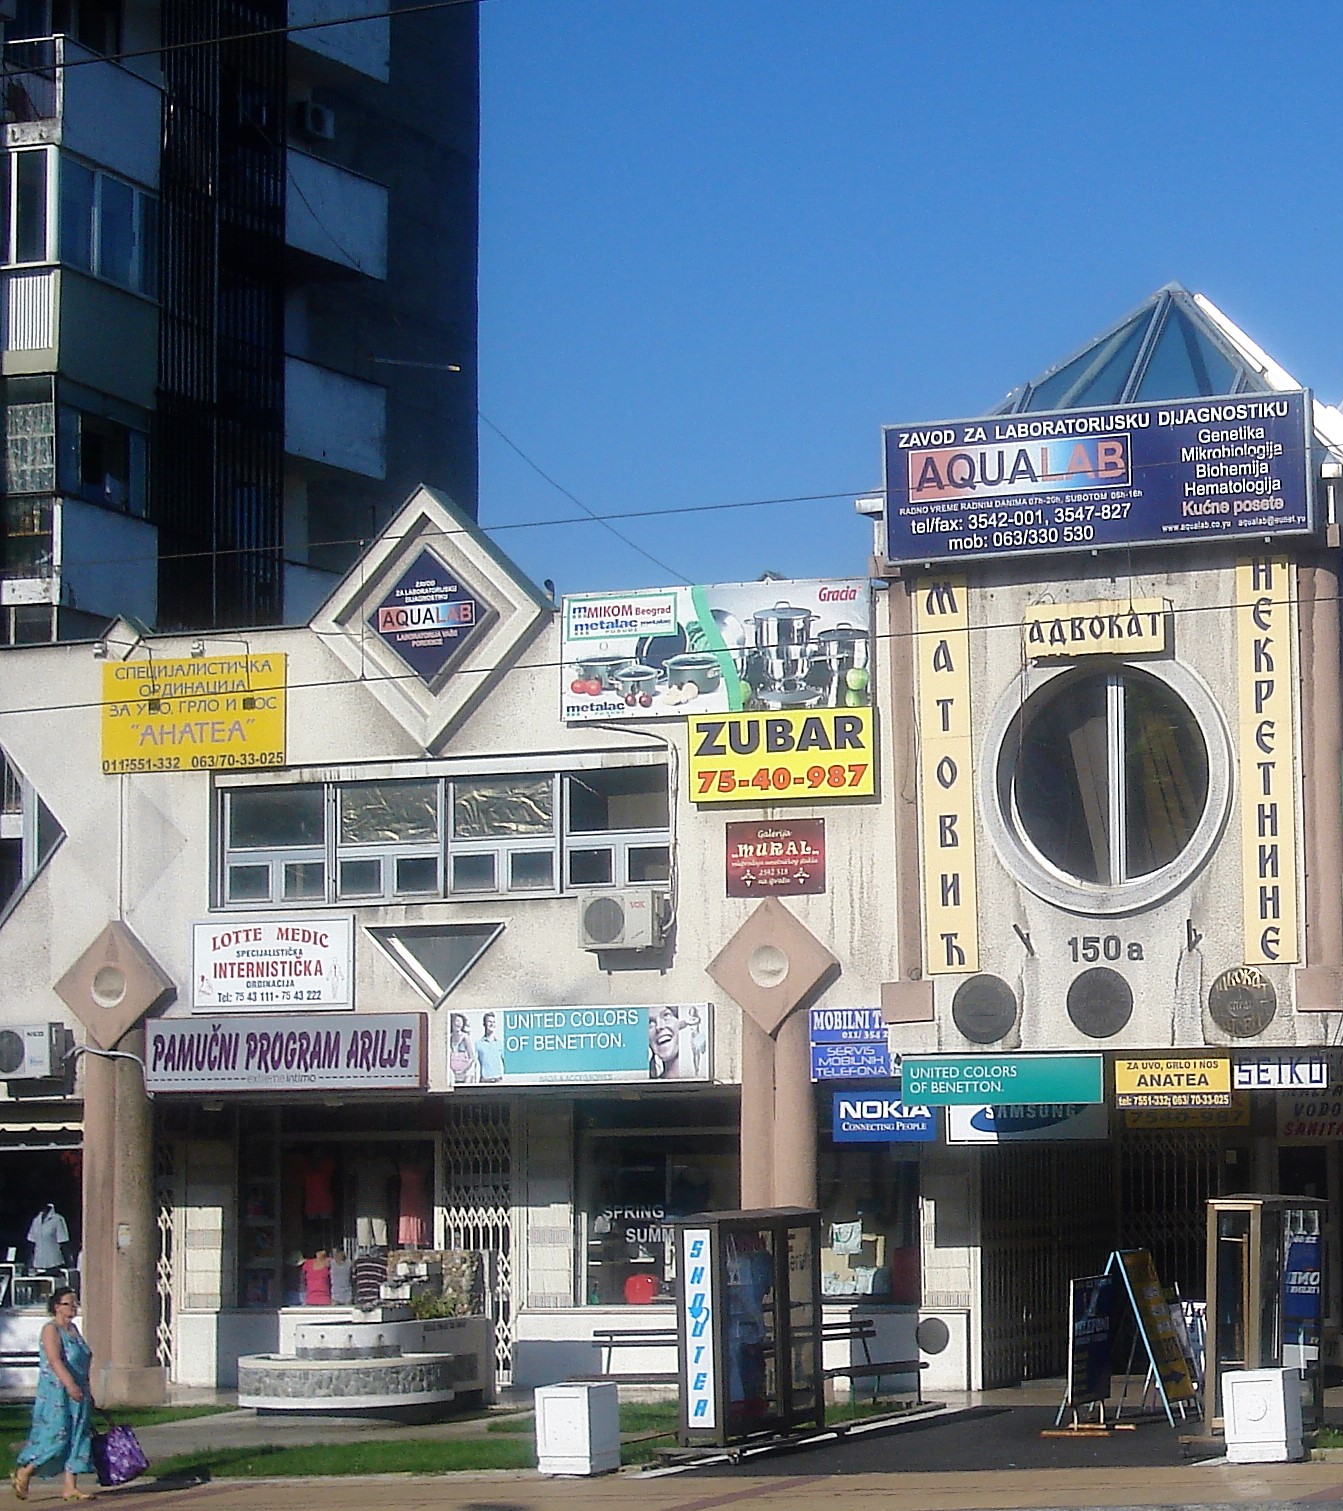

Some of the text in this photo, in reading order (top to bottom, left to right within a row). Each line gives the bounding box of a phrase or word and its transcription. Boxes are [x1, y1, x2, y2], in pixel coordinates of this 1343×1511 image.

[898, 401, 1288, 449] ZAVOD ZA LABORATORIJSKU DIJAGNOSTIKU
[1197, 425, 1265, 444] Genetika
[1181, 441, 1284, 463] Mikrobiologija
[915, 441, 1127, 493] AQUALAB
[1196, 459, 1269, 479] Biohemija
[1184, 477, 1282, 497] Hematologija
[1182, 495, 1285, 517] Kućne posete
[910, 502, 1132, 535] tel/fax: 3542-001, 3547-827
[948, 525, 1094, 551] mob: 063/330 530
[818, 586, 857, 603] Gracia
[382, 603, 473, 628] AQUALAB
[587, 604, 672, 619] MIKOM Beograd
[574, 619, 639, 632] metalac
[1029, 611, 1162, 646] АДВОКАТ
[115, 659, 273, 681] СПЕЦИЈАЛИСТИЧКА
[139, 679, 247, 698] ОРДИНАЦИЈА
[109, 696, 278, 718] ЗА ГРЛО И ОС
[566, 701, 626, 713] metalac
[694, 715, 867, 757] ZUBAR
[191, 751, 284, 769] 063/70-33-025
[697, 763, 869, 794] 75-40-987
[925, 579, 966, 967] МАТОВИЋ
[757, 828, 793, 840] Galerija
[211, 927, 330, 952] LOTTE MEDIC
[213, 956, 324, 979] INTERNISTIČKA
[217, 991, 233, 1003] Tel:
[235, 991, 245, 1002] 75
[247, 991, 258, 1002] 43
[281, 990, 292, 1001] 75
[293, 990, 304, 1001] 43
[306, 989, 322, 1001] 222
[506, 1009, 639, 1030] UNITED COLORS
[813, 1010, 870, 1031] MOBILNI
[152, 1023, 413, 1074] PAMUČNI PROGRAM ARILJE
[506, 1032, 627, 1052] OF BENETTON.
[826, 1046, 875, 1056] SERVIS
[815, 1066, 888, 1077] TELEFONA
[817, 1056, 884, 1067] MOBILNIH
[1126, 1061, 1140, 1070] ZA
[1141, 1061, 1164, 1071] UVO,
[1165, 1060, 1190, 1070] GRLO
[1198, 1060, 1219, 1069] NOS
[1237, 1055, 1328, 1086] SEIKO
[909, 1066, 1018, 1080] UNITED COLORS
[1136, 1073, 1209, 1087] ANATEA
[909, 1080, 1005, 1094] OF BENETTON.
[839, 1100, 932, 1120] NOKIA
[1118, 1095, 1131, 1106] tel:
[984, 1104, 1077, 1121] SAMSUNG
[841, 1121, 928, 1131] CONNECTING PEOPLE
[602, 1203, 665, 1219] SPRING
